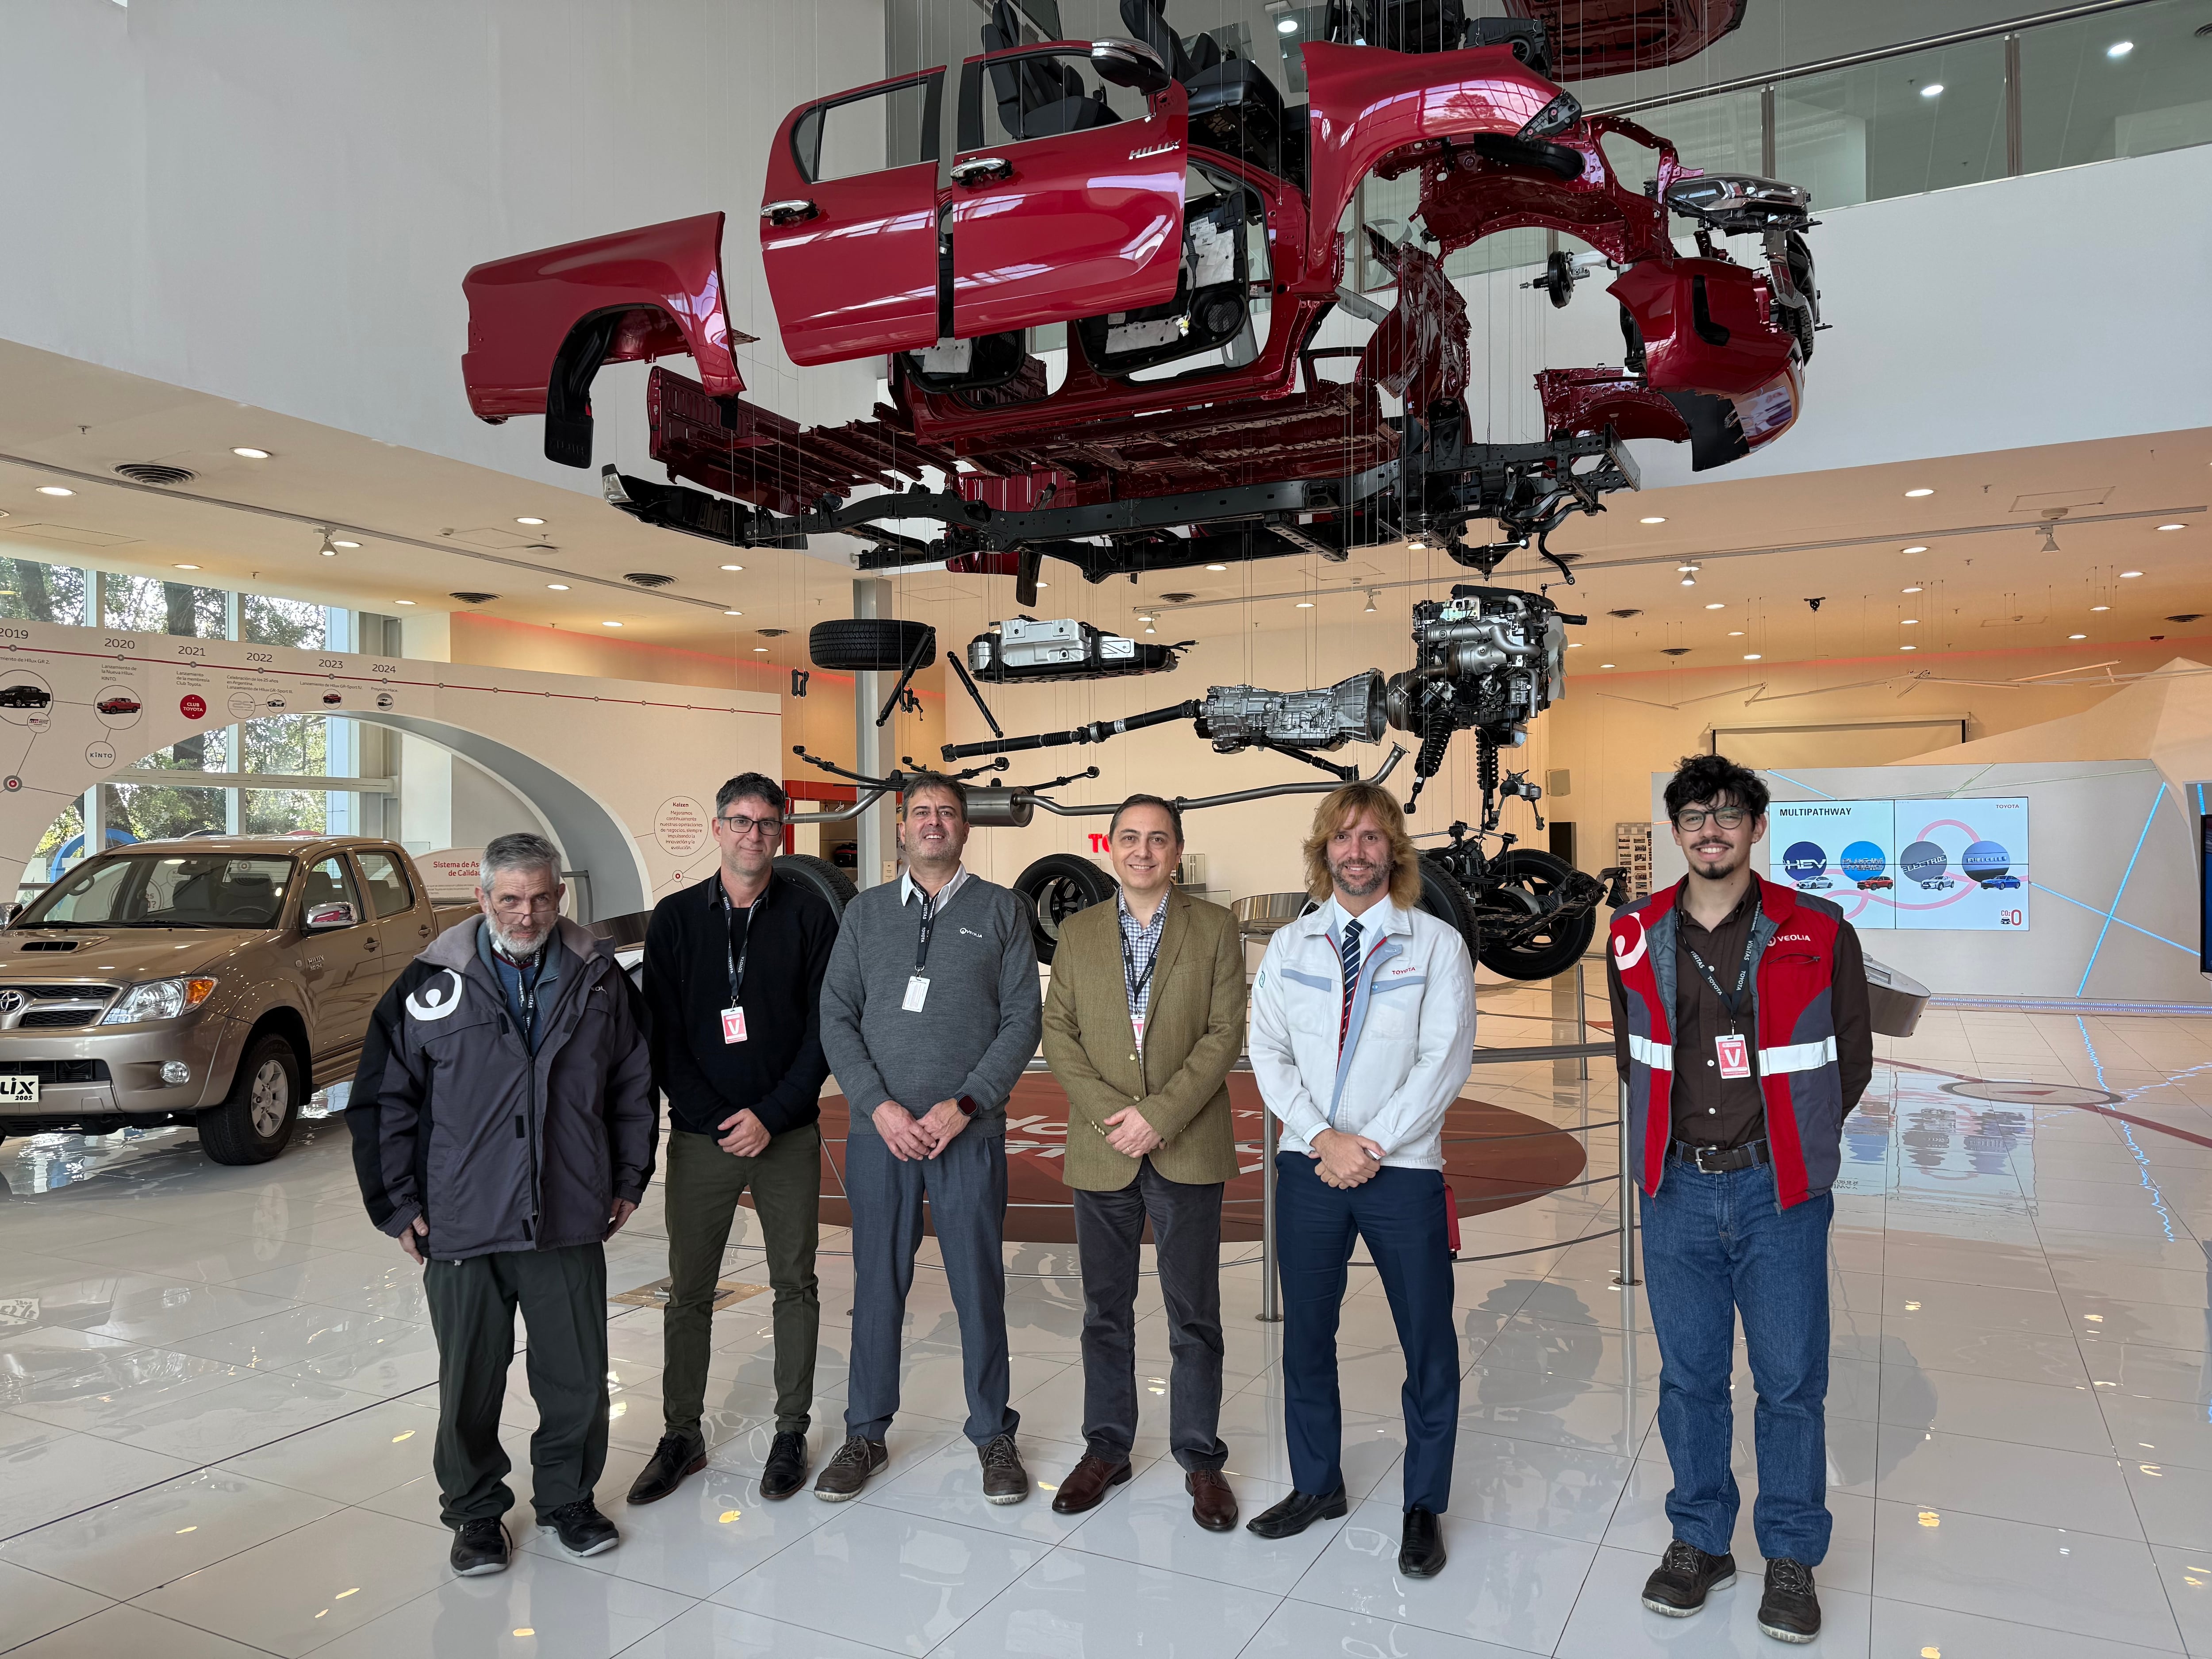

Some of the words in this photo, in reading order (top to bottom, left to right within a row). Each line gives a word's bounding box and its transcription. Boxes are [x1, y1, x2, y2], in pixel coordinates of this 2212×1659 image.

[1129, 138, 1181, 160] HILUX
[0, 628, 28, 639] 2019
[104, 638, 135, 649] 2020
[178, 646, 206, 656] 2021
[246, 652, 273, 662] 2022
[319, 659, 343, 668] 2023
[372, 664, 396, 673] 2024
[1786, 859, 1826, 870] HEV
[1901, 854, 1946, 873] ELECTRIC
[1744, 941, 1753, 960] VISITAS
[307, 955, 324, 965] HILUX
[1690, 951, 1705, 968] VISITAS
[1142, 966, 1152, 981] TOYOTA
[1736, 971, 1746, 991] TOYOTA
[1708, 975, 1722, 996] TOYOTA
[727, 1019, 740, 1035] V
[1724, 1048, 1741, 1067] V
